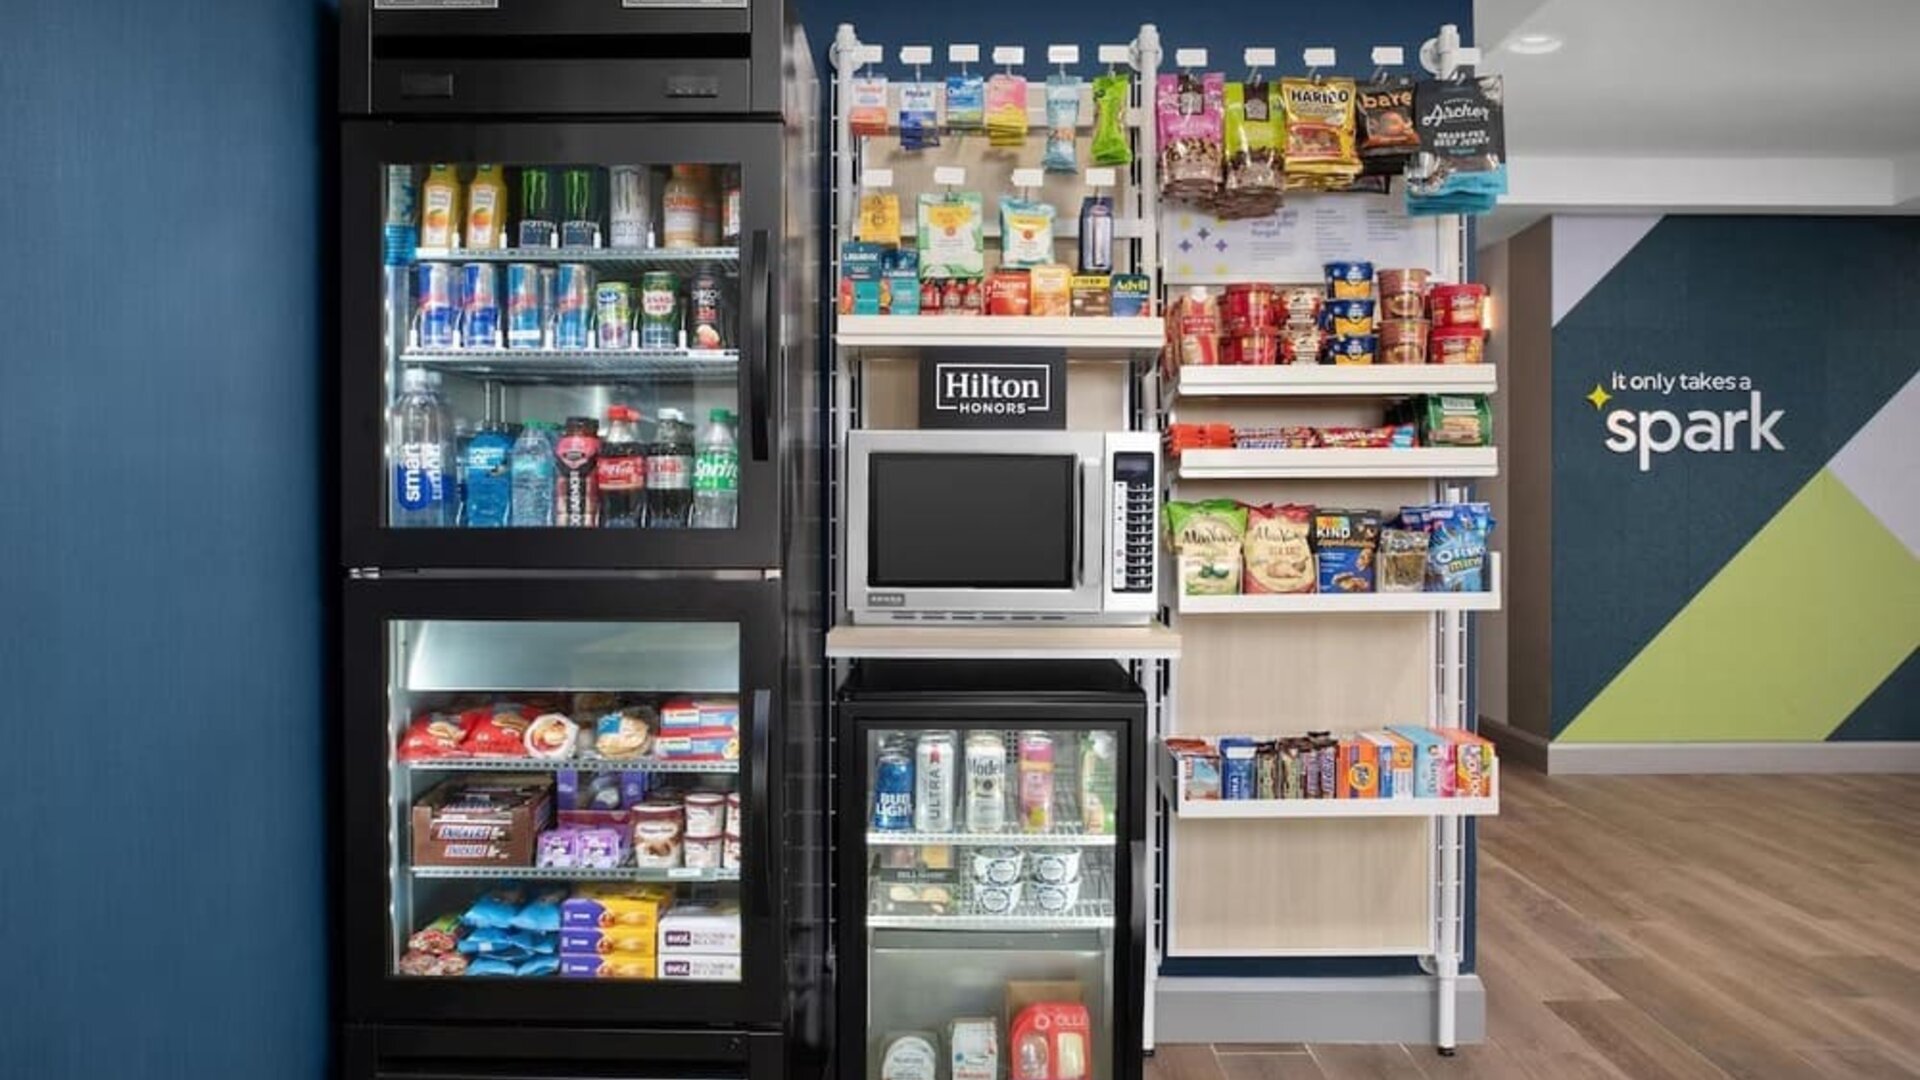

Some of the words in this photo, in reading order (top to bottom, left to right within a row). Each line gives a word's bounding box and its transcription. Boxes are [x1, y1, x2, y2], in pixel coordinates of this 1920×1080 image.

[1361, 91, 1413, 109] bare
[1421, 103, 1490, 127] Archer
[1114, 279, 1149, 292] Advil
[945, 373, 1040, 398] Hilton
[1611, 370, 1626, 390] it
[1630, 372, 1676, 395] only
[1680, 371, 1736, 390] takes
[1738, 375, 1752, 390] a
[959, 402, 1026, 414] HONORS
[1605, 390, 1786, 471] spark
[404, 442, 422, 502] smart
[1316, 527, 1350, 539] KIND
[880, 793, 911, 804] BUD
[928, 768, 941, 820] ULTRA
[875, 803, 912, 817] LIGHT
